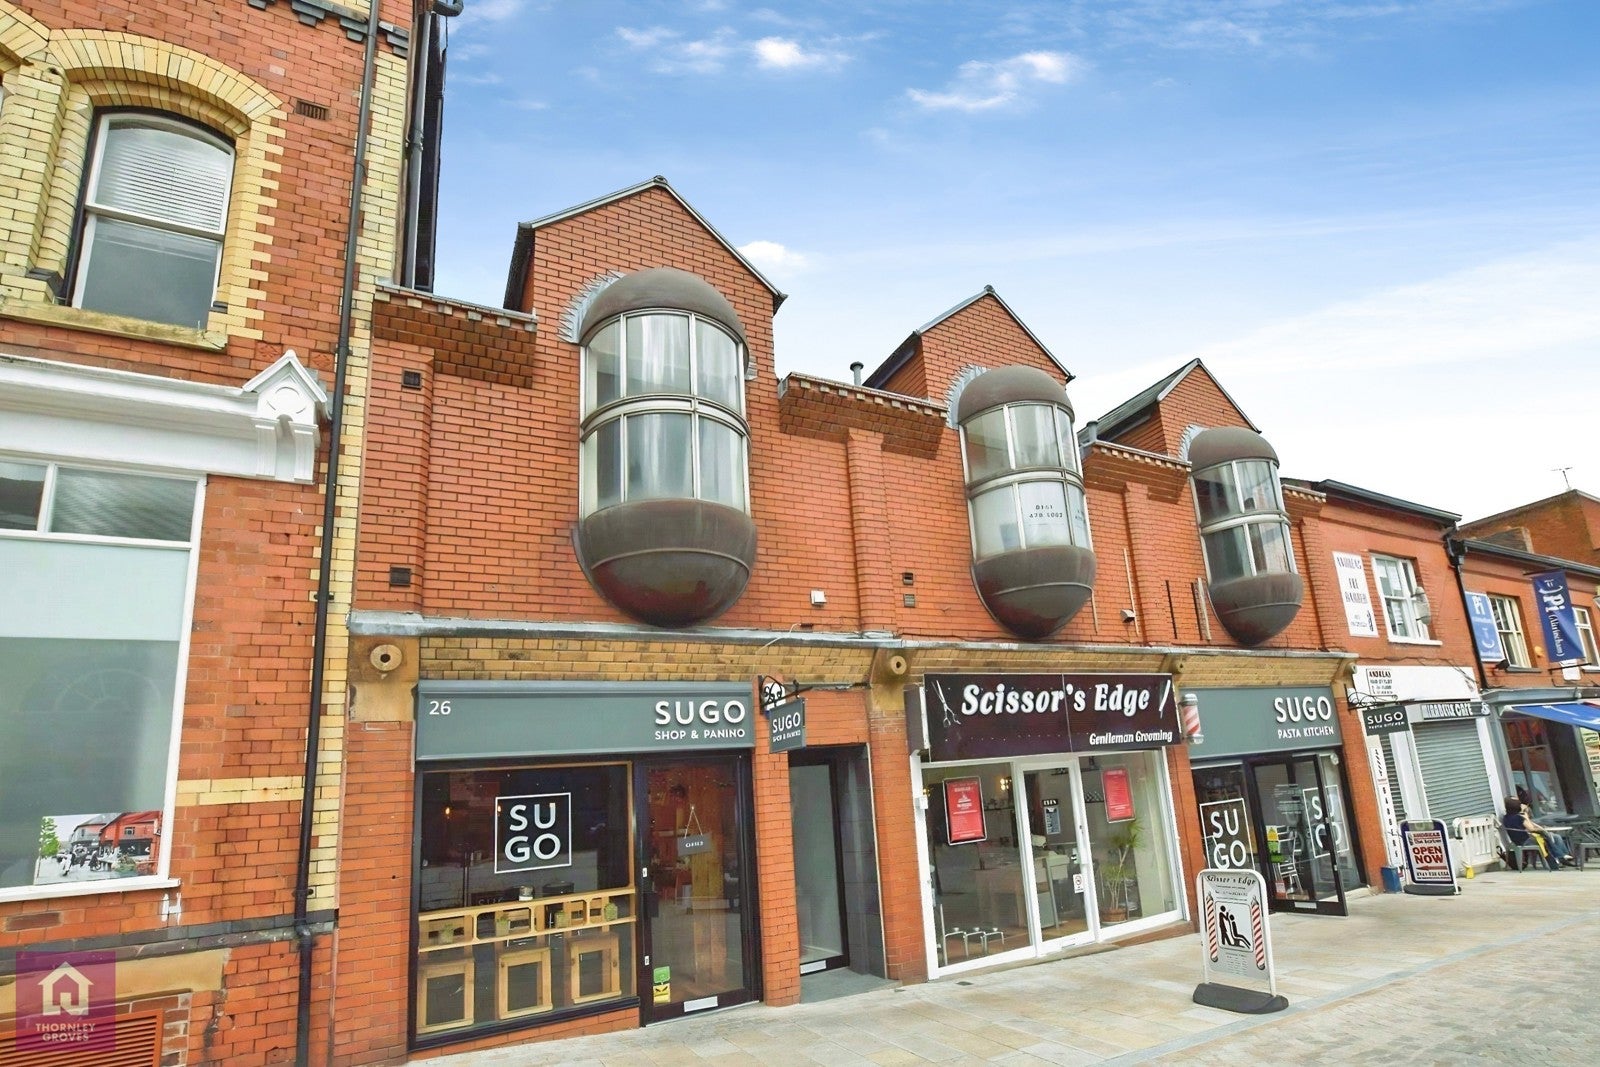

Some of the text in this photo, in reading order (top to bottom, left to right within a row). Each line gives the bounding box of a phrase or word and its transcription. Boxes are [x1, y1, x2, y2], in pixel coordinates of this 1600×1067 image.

[429, 700, 452, 715] 26
[961, 683, 1150, 717] Scissor's Edge
[1274, 696, 1332, 723] SUGO
[655, 699, 746, 725] SUGO
[772, 712, 801, 733] SUGO
[1367, 711, 1404, 725] SUGO
[655, 728, 746, 740] SHOP & PANINO
[1089, 729, 1173, 745] Gentleman Grooming
[1278, 725, 1335, 739] PASTA KITCHEN
[509, 802, 556, 831] SU
[1210, 808, 1240, 839] SU
[504, 833, 561, 863] GO
[1213, 839, 1247, 870] GO
[1412, 846, 1443, 855] OPEN
[1414, 854, 1444, 864] NOW
